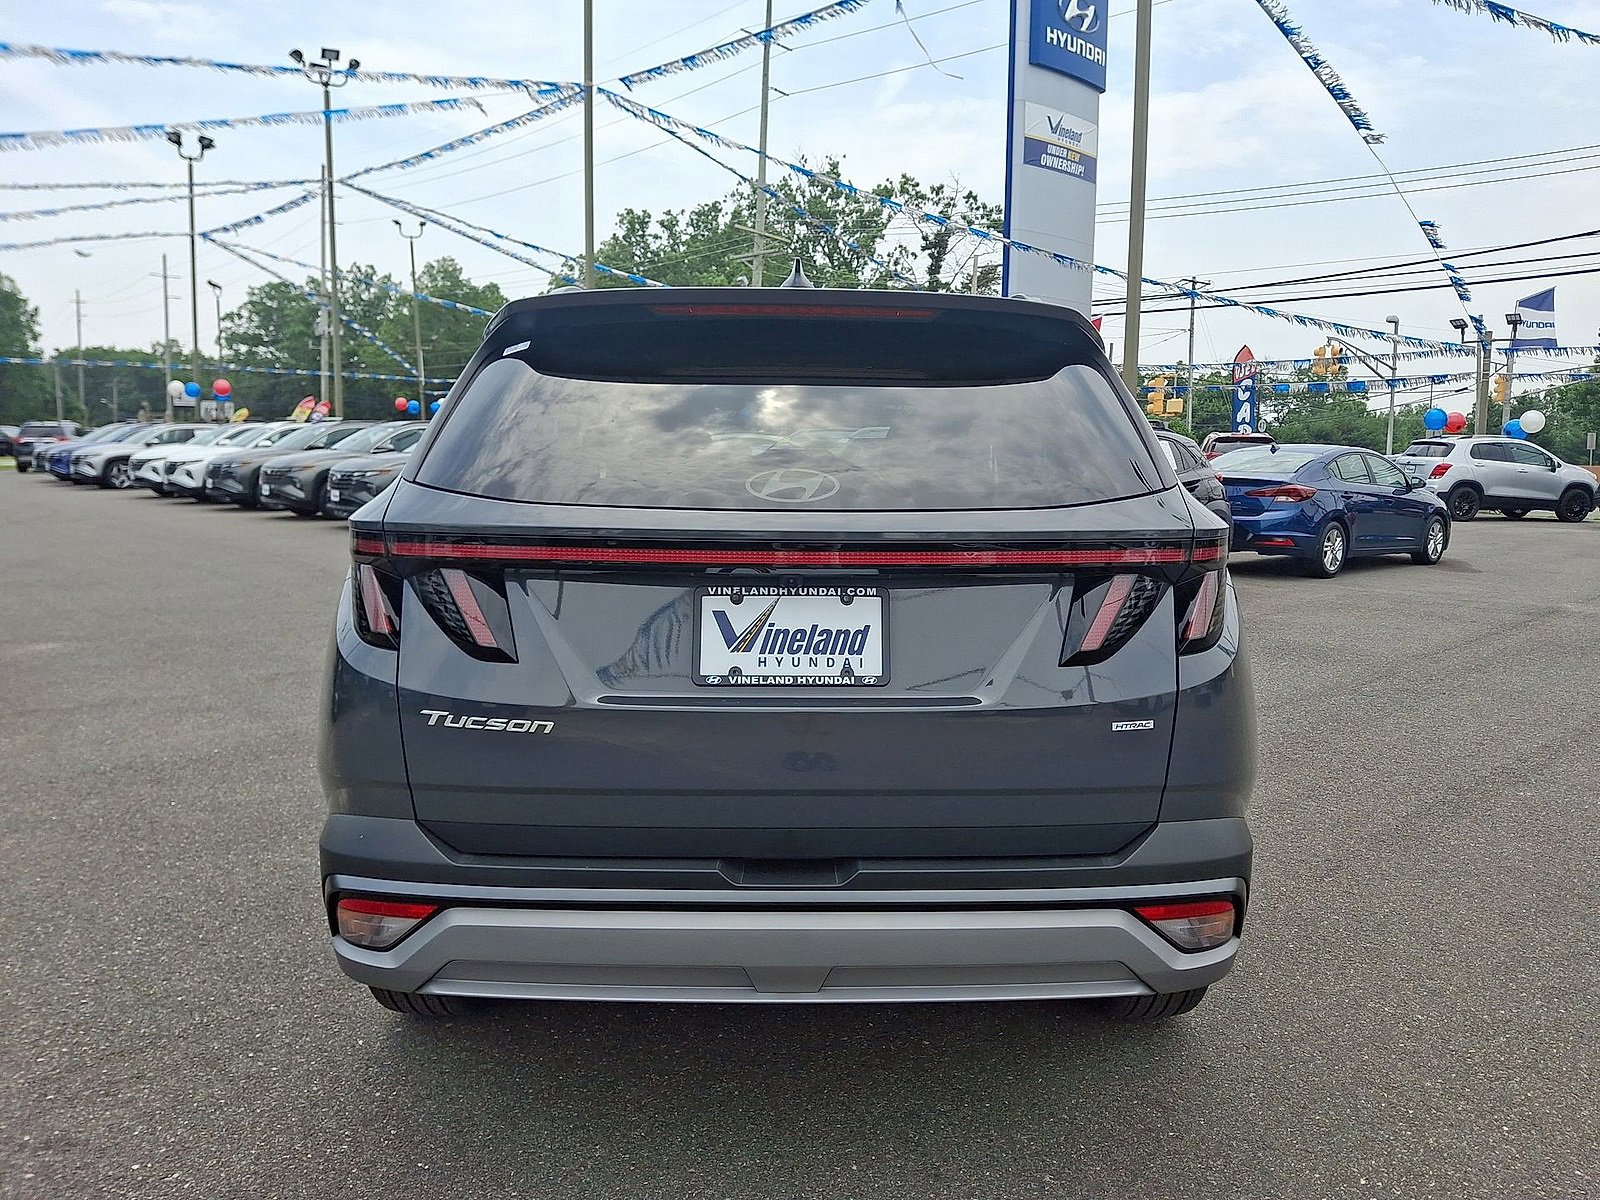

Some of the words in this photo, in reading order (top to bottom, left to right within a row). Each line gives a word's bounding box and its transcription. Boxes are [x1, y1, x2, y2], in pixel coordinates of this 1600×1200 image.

[1046, 26, 1106, 66] HYUNDAI
[1046, 114, 1083, 144] Vineland
[1047, 144, 1068, 158] UNDER
[1040, 153, 1085, 177] OWNERSHIP!
[1519, 319, 1555, 329] YUNDAI
[707, 586, 878, 597] VINELANDHYUNDAI.COM
[712, 596, 871, 656] Vineland
[757, 656, 864, 669] HYUNDAI
[728, 675, 795, 686] VINELAND
[797, 675, 856, 686] HYUNDAI
[1114, 721, 1153, 730] HTRAC
